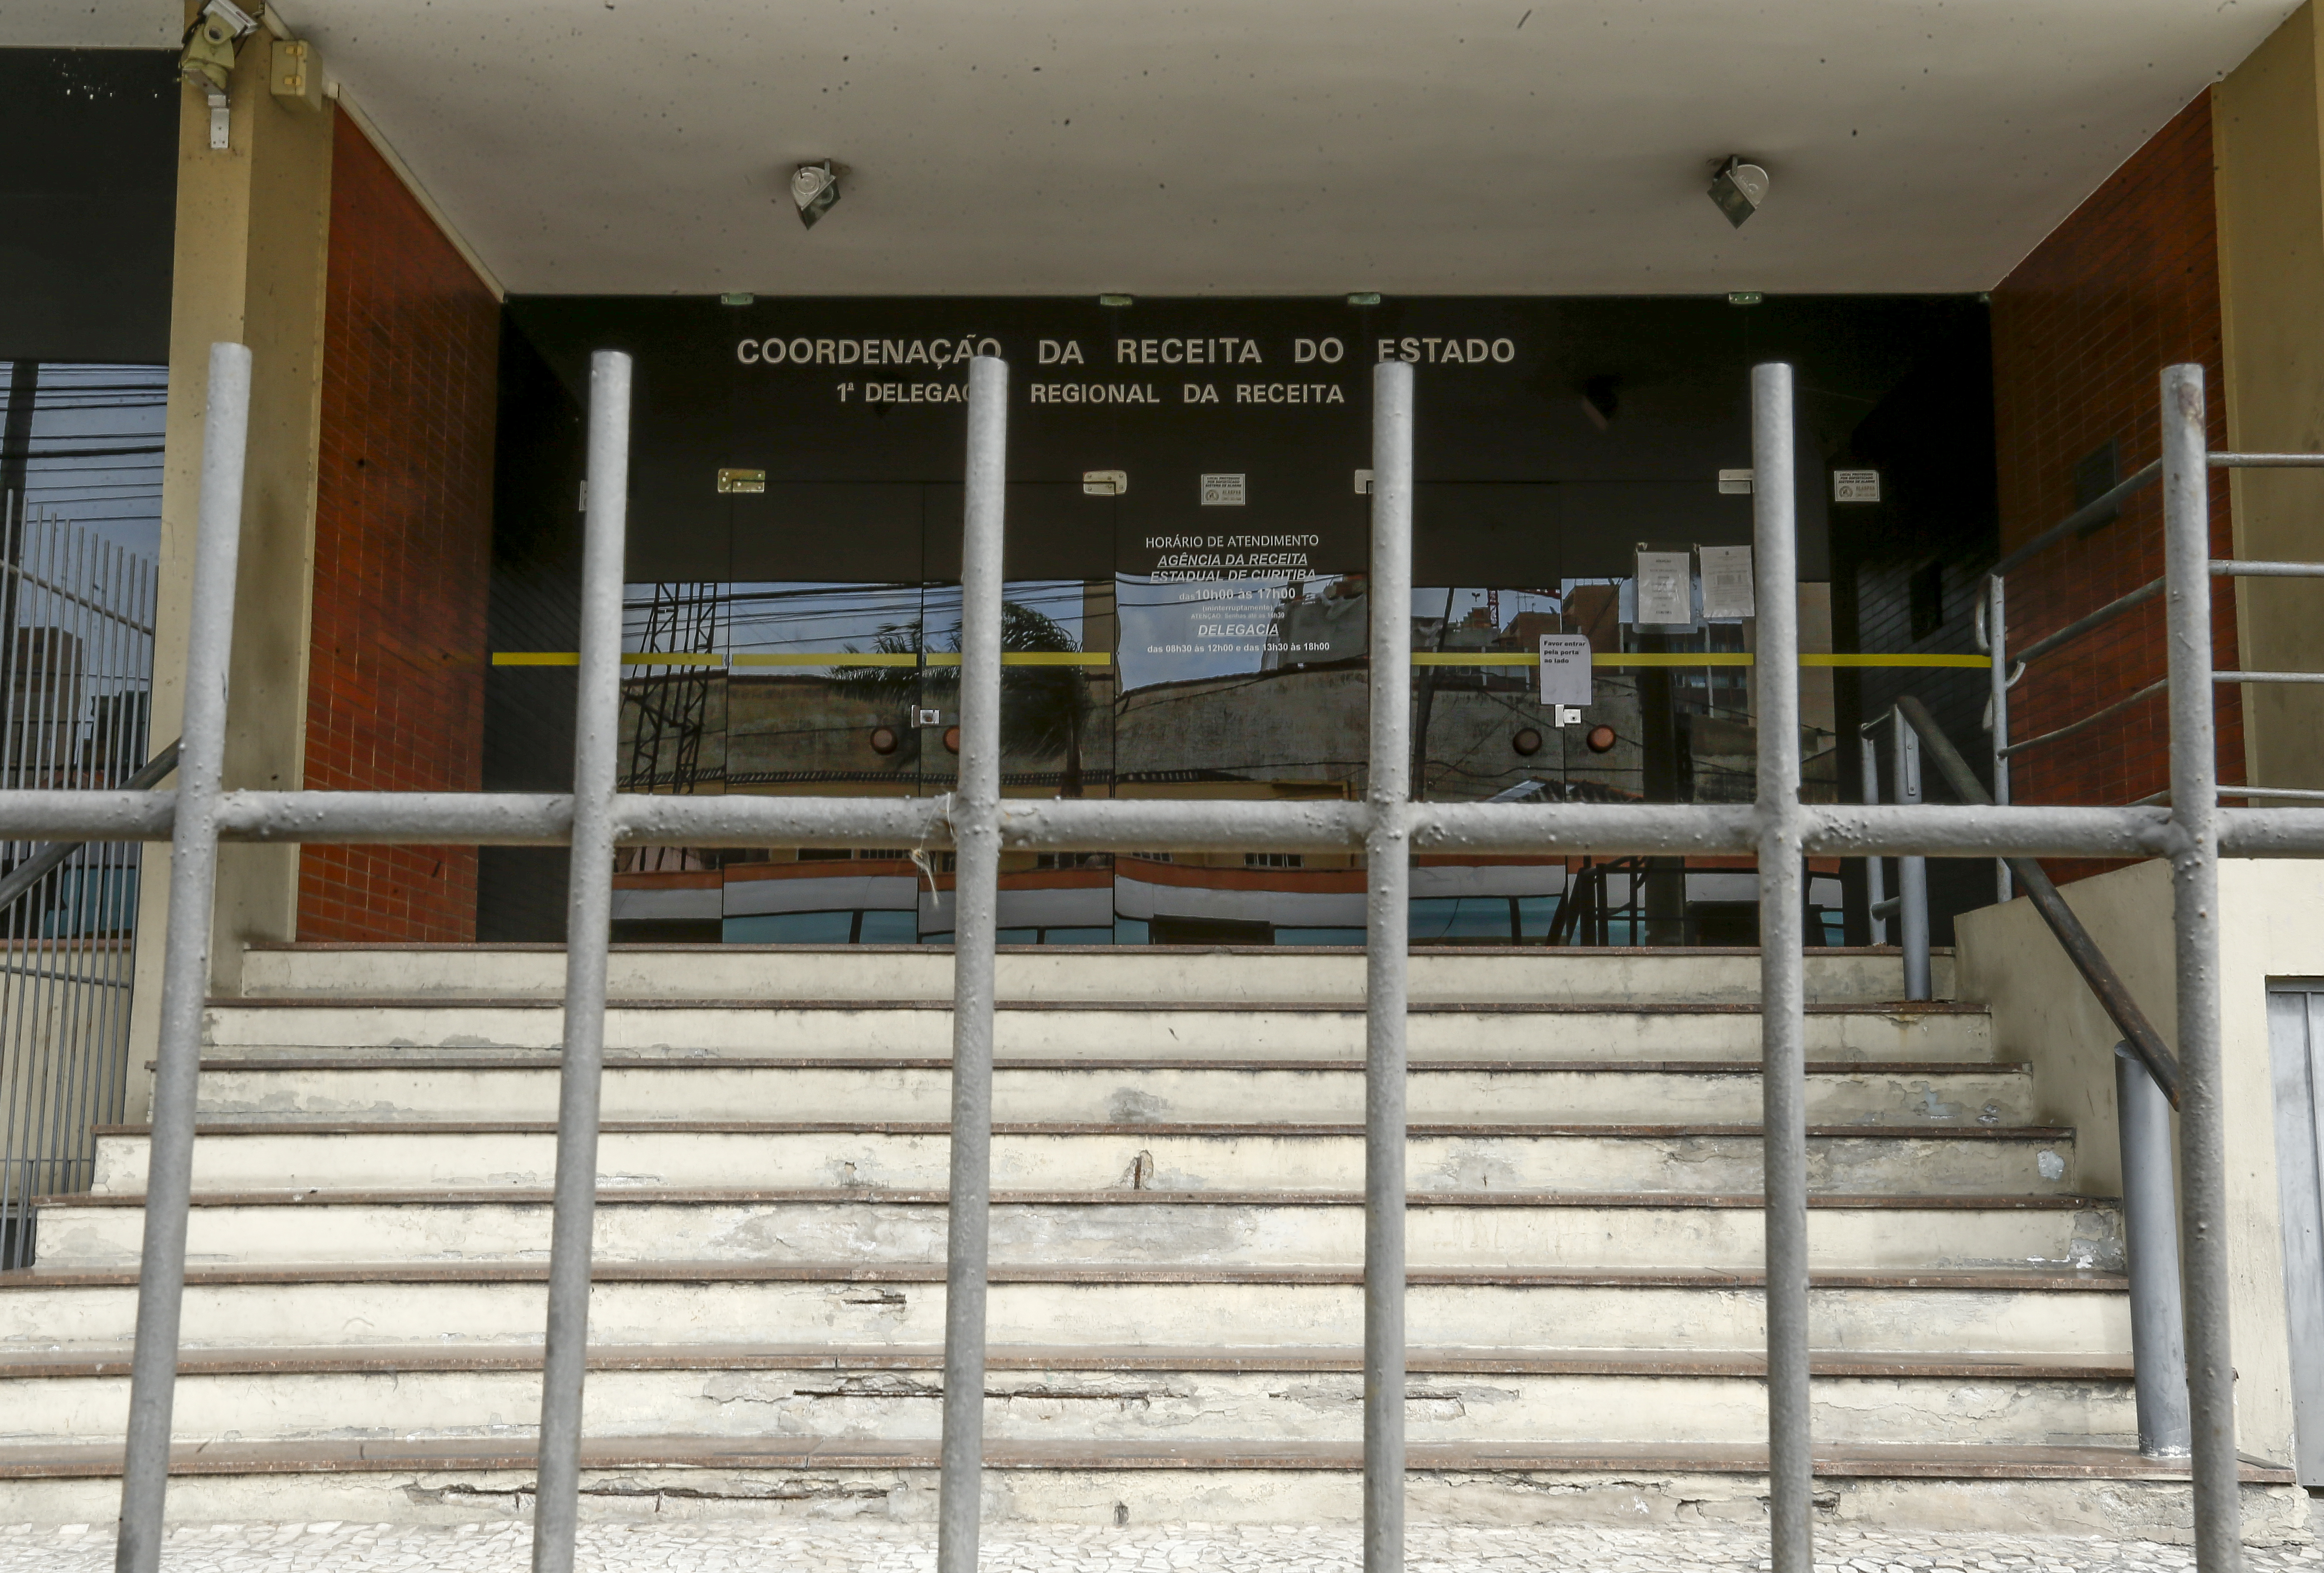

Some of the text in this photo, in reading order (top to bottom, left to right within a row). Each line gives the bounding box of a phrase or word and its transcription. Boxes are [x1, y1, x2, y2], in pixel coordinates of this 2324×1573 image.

[737, 334, 1515, 371] COORDENAÇÃO DA RECEITA DO ESTADO
[865, 382, 969, 403] DELEGA
[1031, 383, 1160, 403] REGIONAL
[1184, 383, 1220, 403] DA
[1236, 383, 1344, 403] RECEITA
[1146, 533, 1319, 548] HORÁRIO DE ATENDIMENTO
[1158, 552, 1308, 566] AGÊNCIA DA RECEITA
[1150, 569, 1316, 582] ESTADUAL DE CURITIBA
[1238, 588, 1253, 599] às
[1257, 588, 1296, 599] 17h00
[1197, 623, 1279, 635] DELEGACIA
[1147, 644, 1163, 653] das
[1165, 644, 1192, 653] 08h30
[1195, 644, 1205, 652] às
[1207, 644, 1233, 652] 12h00
[1244, 643, 1260, 652] das
[1262, 643, 1288, 651] 13h30
[1290, 642, 1301, 651] às
[1304, 642, 1330, 650] 18h00
